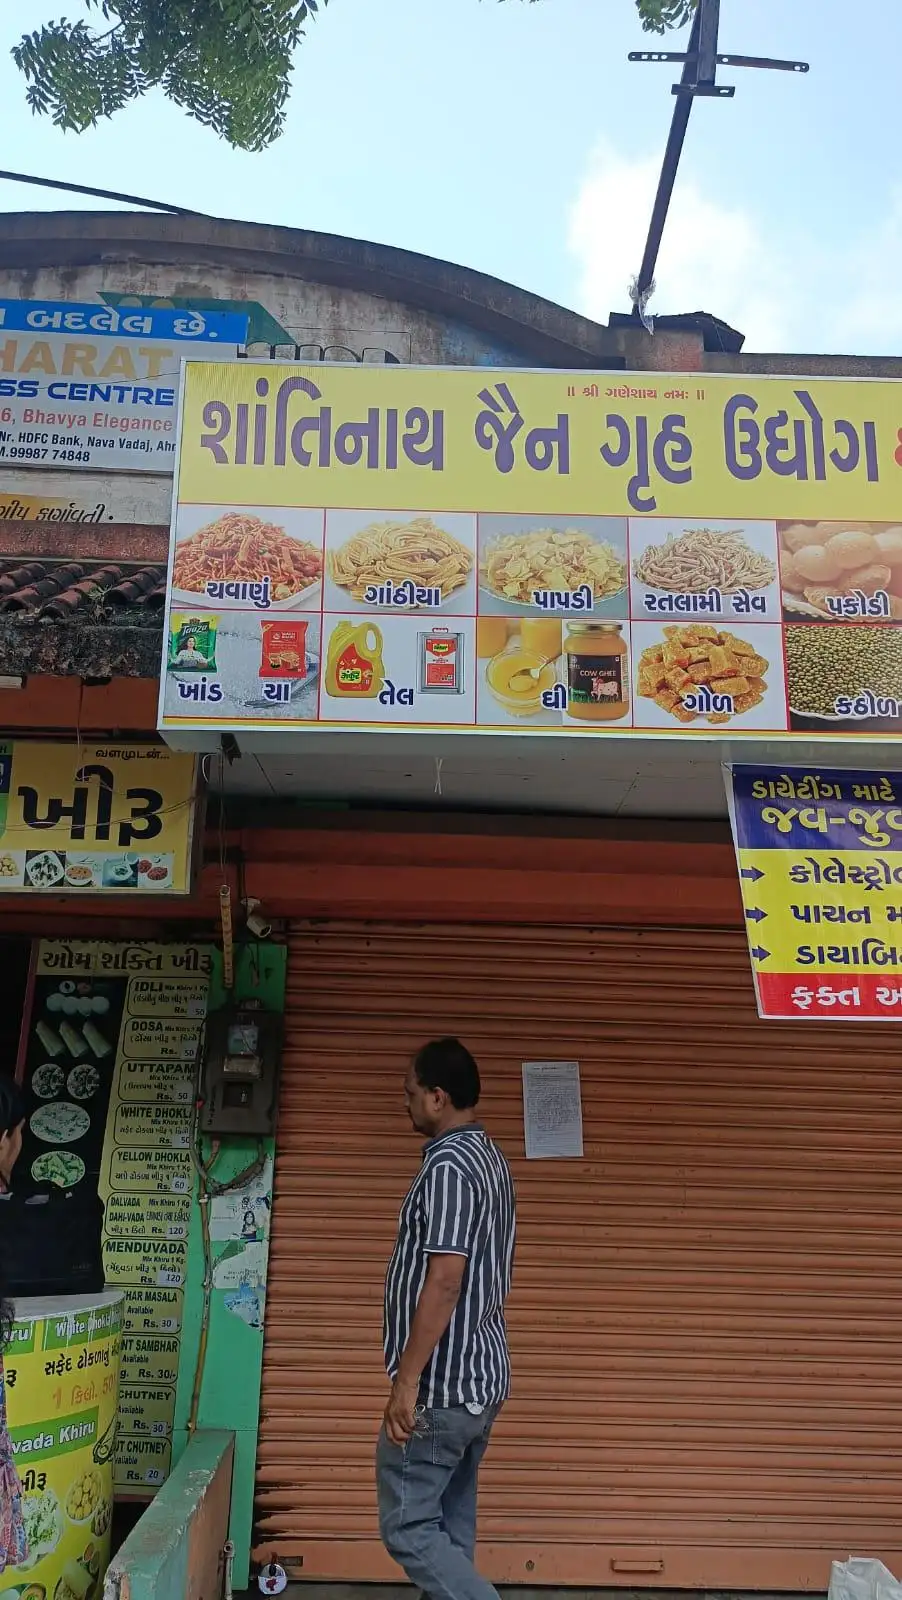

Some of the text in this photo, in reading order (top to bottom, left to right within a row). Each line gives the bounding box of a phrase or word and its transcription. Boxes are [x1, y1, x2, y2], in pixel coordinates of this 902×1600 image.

[27, 306, 153, 334] બદલેલ
[173, 311, 218, 338] છે.
[47, 382, 175, 406] CENTRE
[582, 383, 599, 397] શ્રી
[604, 385, 657, 399] ગણેશાય
[23, 408, 87, 429] Bhavya
[93, 412, 173, 432] Elegance
[0, 431, 14, 443] Nr.
[18, 432, 48, 444] HDFC
[52, 434, 83, 448] Bank,
[87, 436, 115, 449] Nava
[119, 438, 153, 453] Vadaj,
[200, 376, 444, 471] શાંતિનાથ
[475, 382, 570, 475] જૈન
[600, 413, 693, 512] ગૃહ
[52, 449, 91, 462] 74848
[206, 576, 271, 608] ચવાણું
[364, 580, 440, 606] ગાંઠીયા
[533, 586, 592, 609] પાપડી
[644, 587, 767, 613] રતલામી સેવ
[826, 590, 889, 615] પકોડી
[178, 680, 223, 703] ખાંડ
[265, 683, 290, 701] ચા
[379, 680, 414, 706] તેલ
[542, 684, 567, 709] ઘી
[684, 686, 733, 713] ગોળ
[836, 689, 899, 717] કઠોળ
[752, 775, 896, 802] ડાયેટીંગ માટે
[17, 764, 164, 847] ખીરૂ
[43, 946, 91, 970] ઓમ
[101, 947, 163, 971] શક્તિ
[795, 938, 902, 966] ડાયાબિ
[135, 981, 163, 992] IDLI
[132, 1021, 163, 1031] DOSA
[120, 1106, 152, 1118] WHITE
[117, 1151, 190, 1163] YELLOW DHOKLA
[157, 1181, 185, 1190] Rs. 60
[110, 1197, 140, 1207] DALVADA
[109, 1212, 145, 1222] DAHI-VADA
[169, 1227, 184, 1235] 120
[106, 1241, 185, 1254] MENDUVADA
[167, 1274, 181, 1282] 120
[123, 1291, 178, 1302] HAR MASALA
[127, 1306, 153, 1314] Available
[143, 1319, 159, 1328] Rs.
[161, 1319, 172, 1327] 30
[136, 1339, 178, 1352] SAMBHAR
[44, 1353, 73, 1376] સફેદ
[122, 1354, 149, 1363] Available
[139, 1368, 154, 1378] Rs.
[119, 1390, 171, 1401] CHUTNEY
[60, 1420, 95, 1443] Khiru
[133, 1419, 149, 1429] Rs.
[127, 1440, 167, 1454] CHUTNEY
[126, 1469, 159, 1480] Rs. 20
